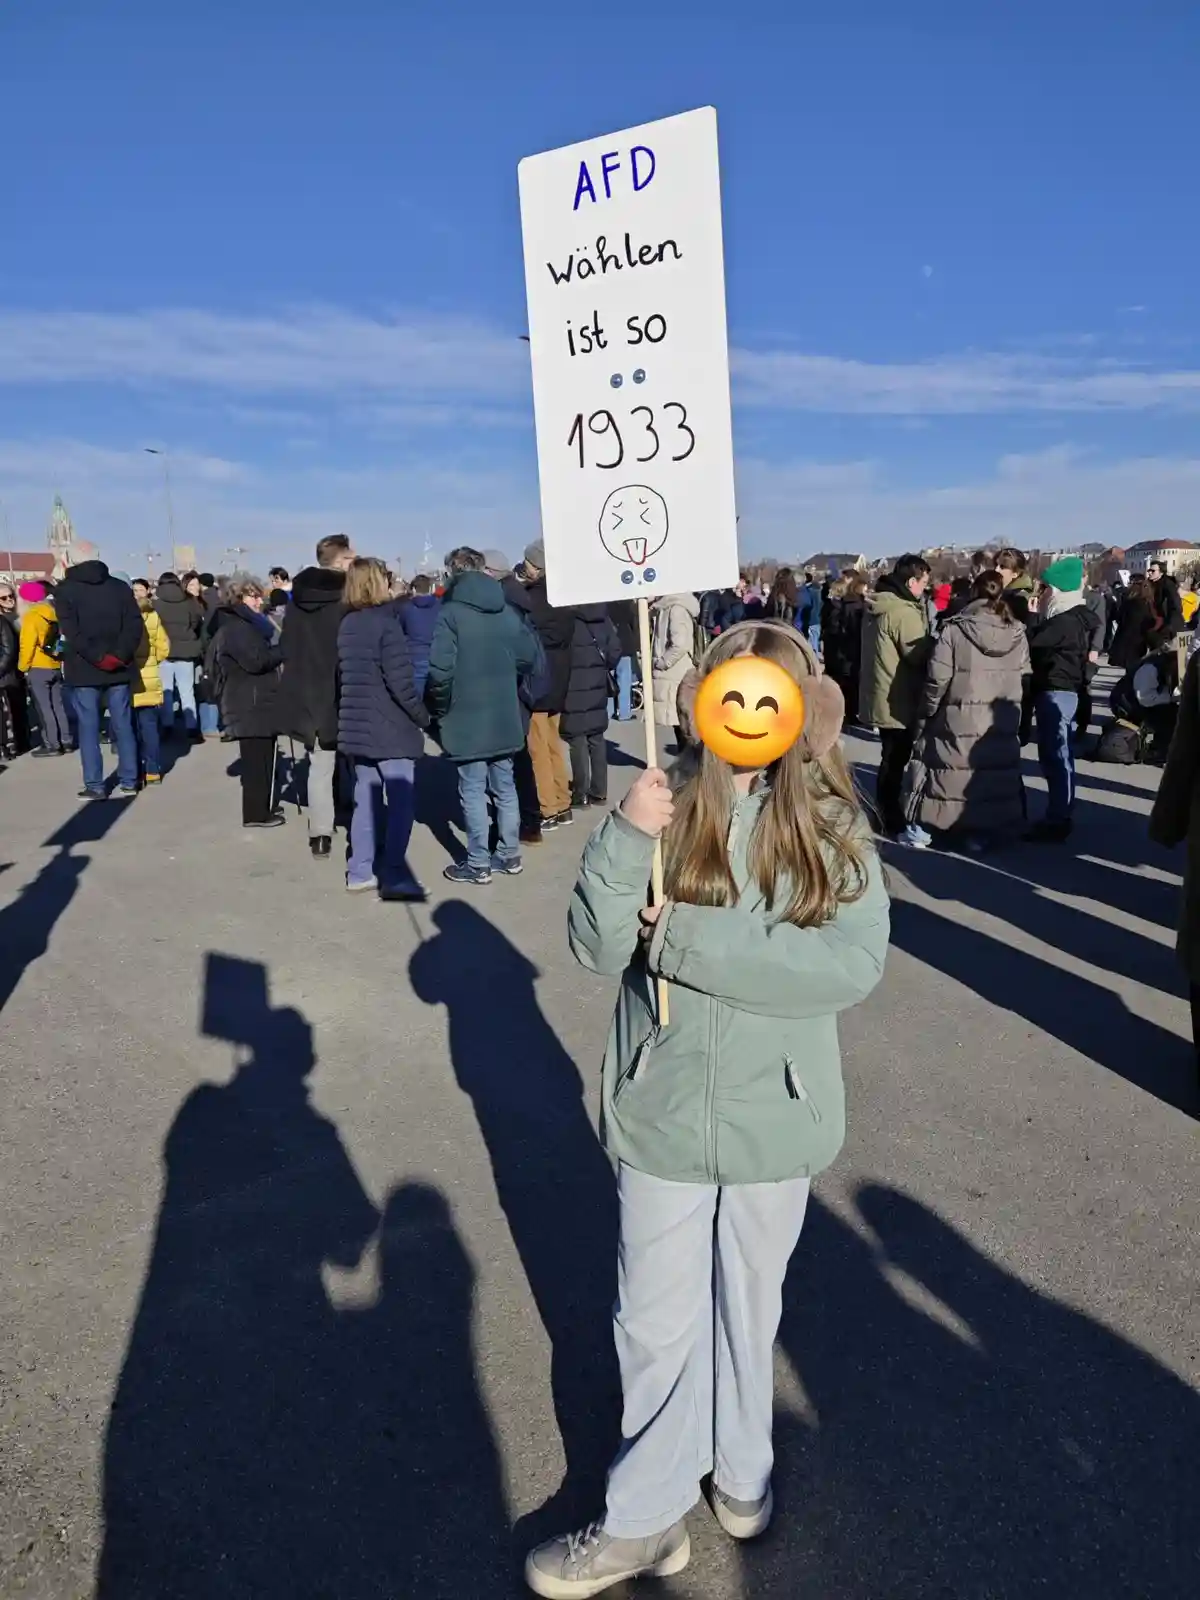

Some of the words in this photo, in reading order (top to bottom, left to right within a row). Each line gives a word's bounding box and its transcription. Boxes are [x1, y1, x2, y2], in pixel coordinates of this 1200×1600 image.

[572, 145, 656, 211] AFD
[546, 232, 683, 286] wählen
[566, 309, 609, 357] ist
[626, 313, 667, 345] so
[567, 401, 695, 470] 1933
